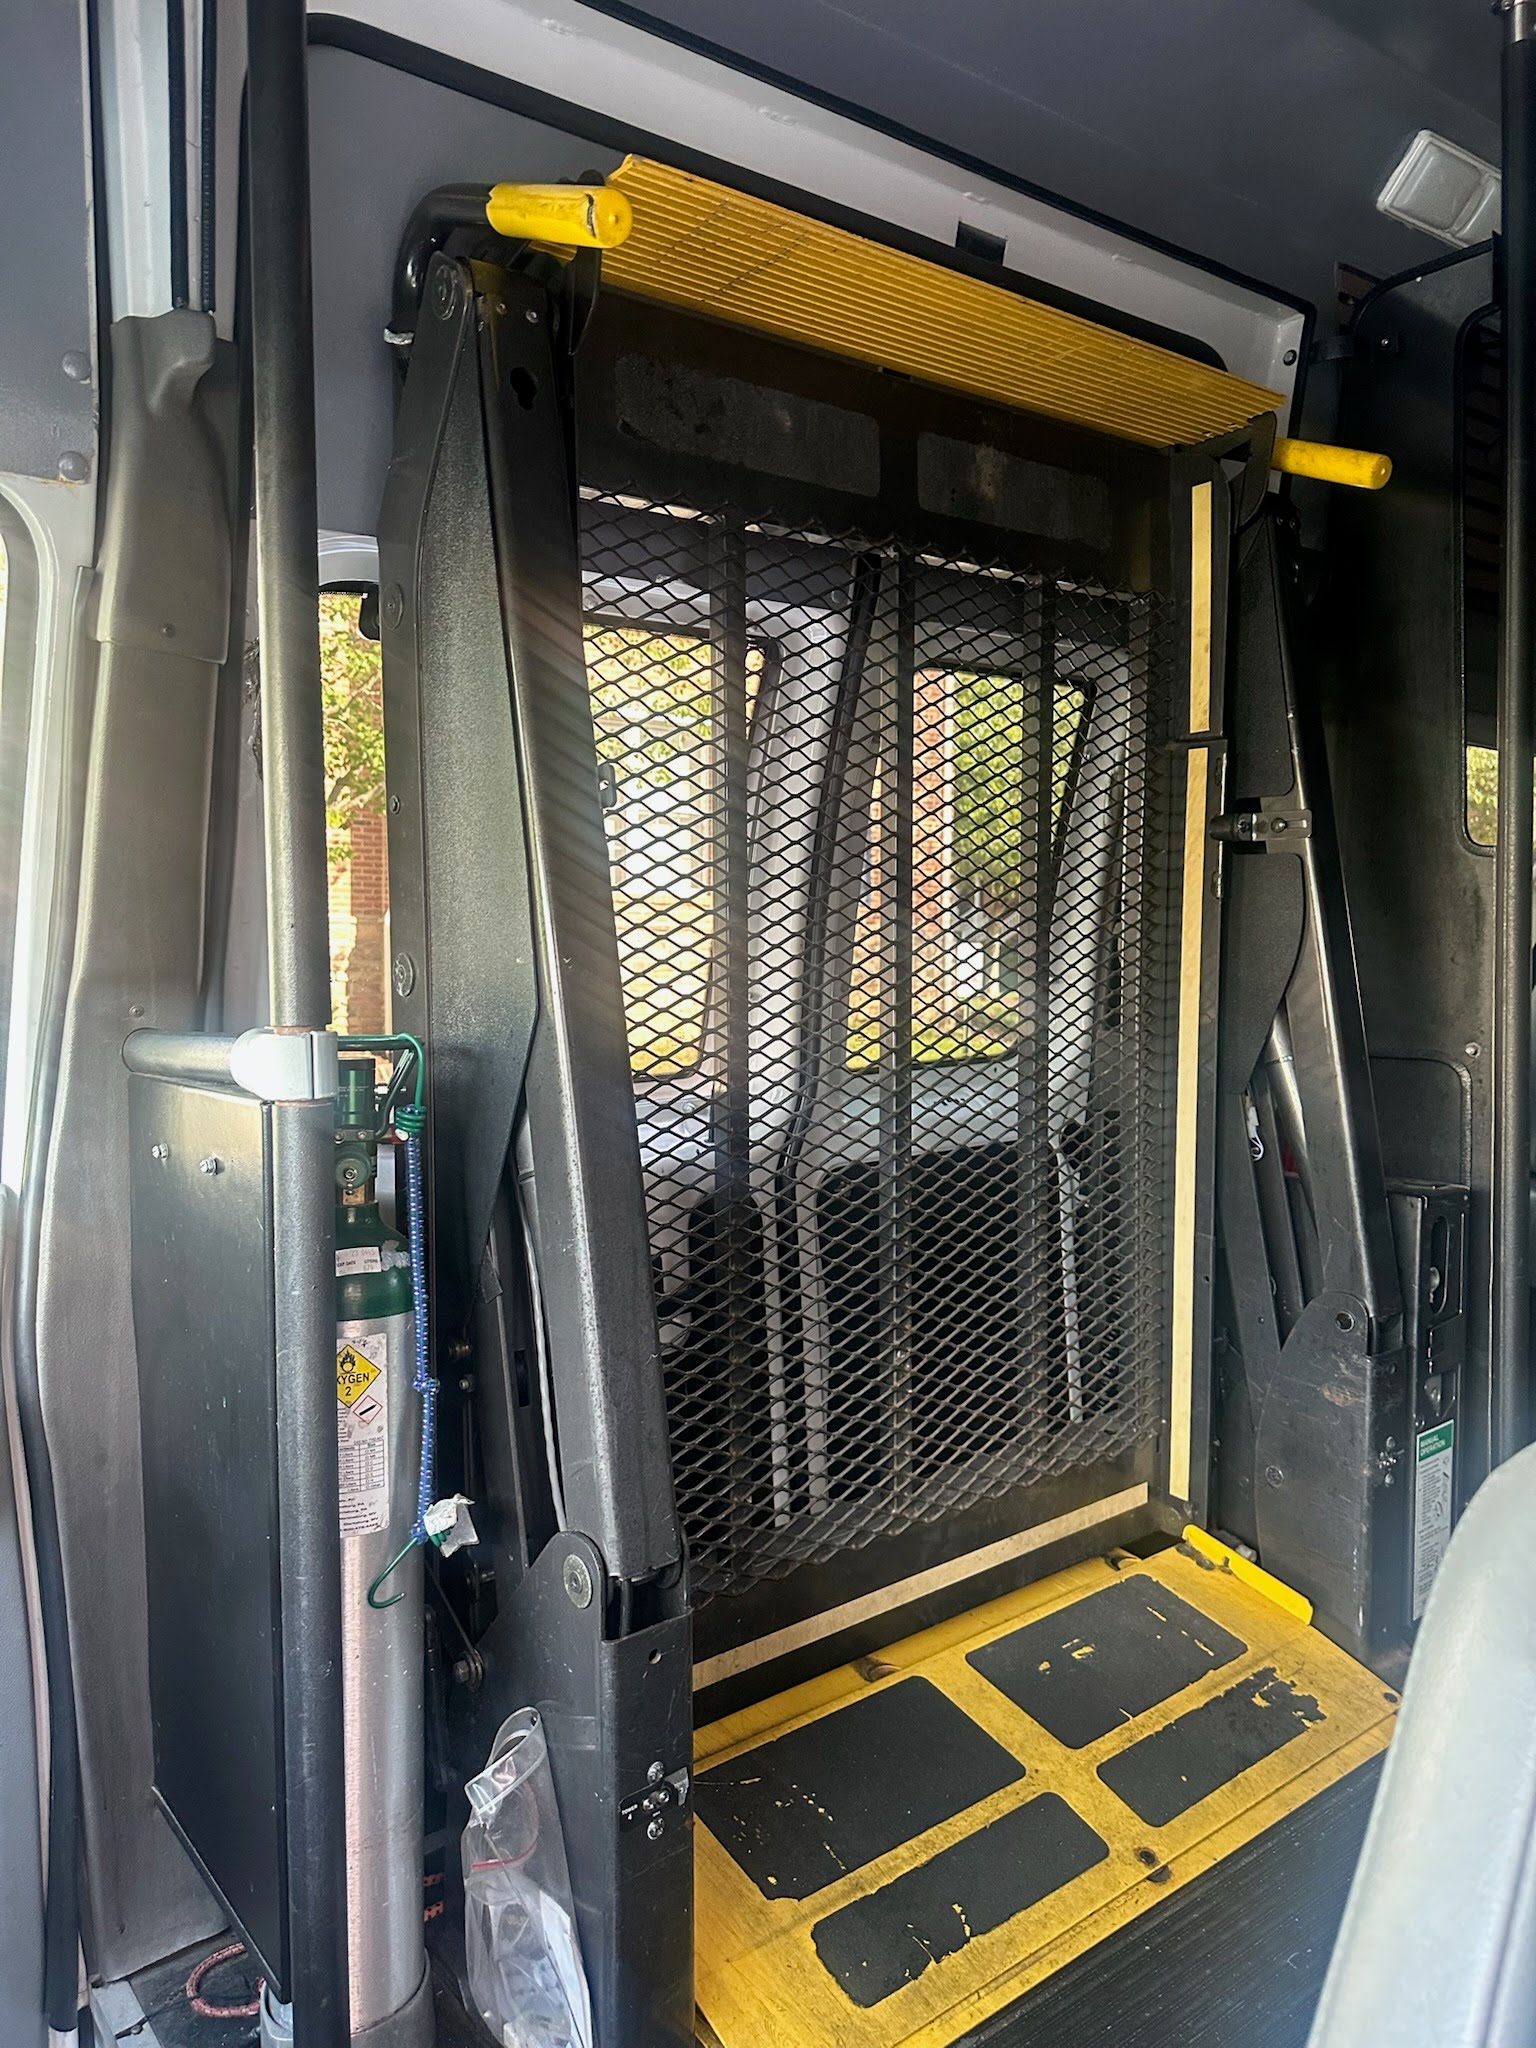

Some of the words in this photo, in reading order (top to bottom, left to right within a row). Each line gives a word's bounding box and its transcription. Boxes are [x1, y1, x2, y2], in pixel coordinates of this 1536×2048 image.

[345, 1386, 352, 1397] 2
[1421, 1434, 1439, 1447] MANUAL
[1420, 1439, 1445, 1456] OPERATION
[622, 1804, 638, 1815] TOWER
